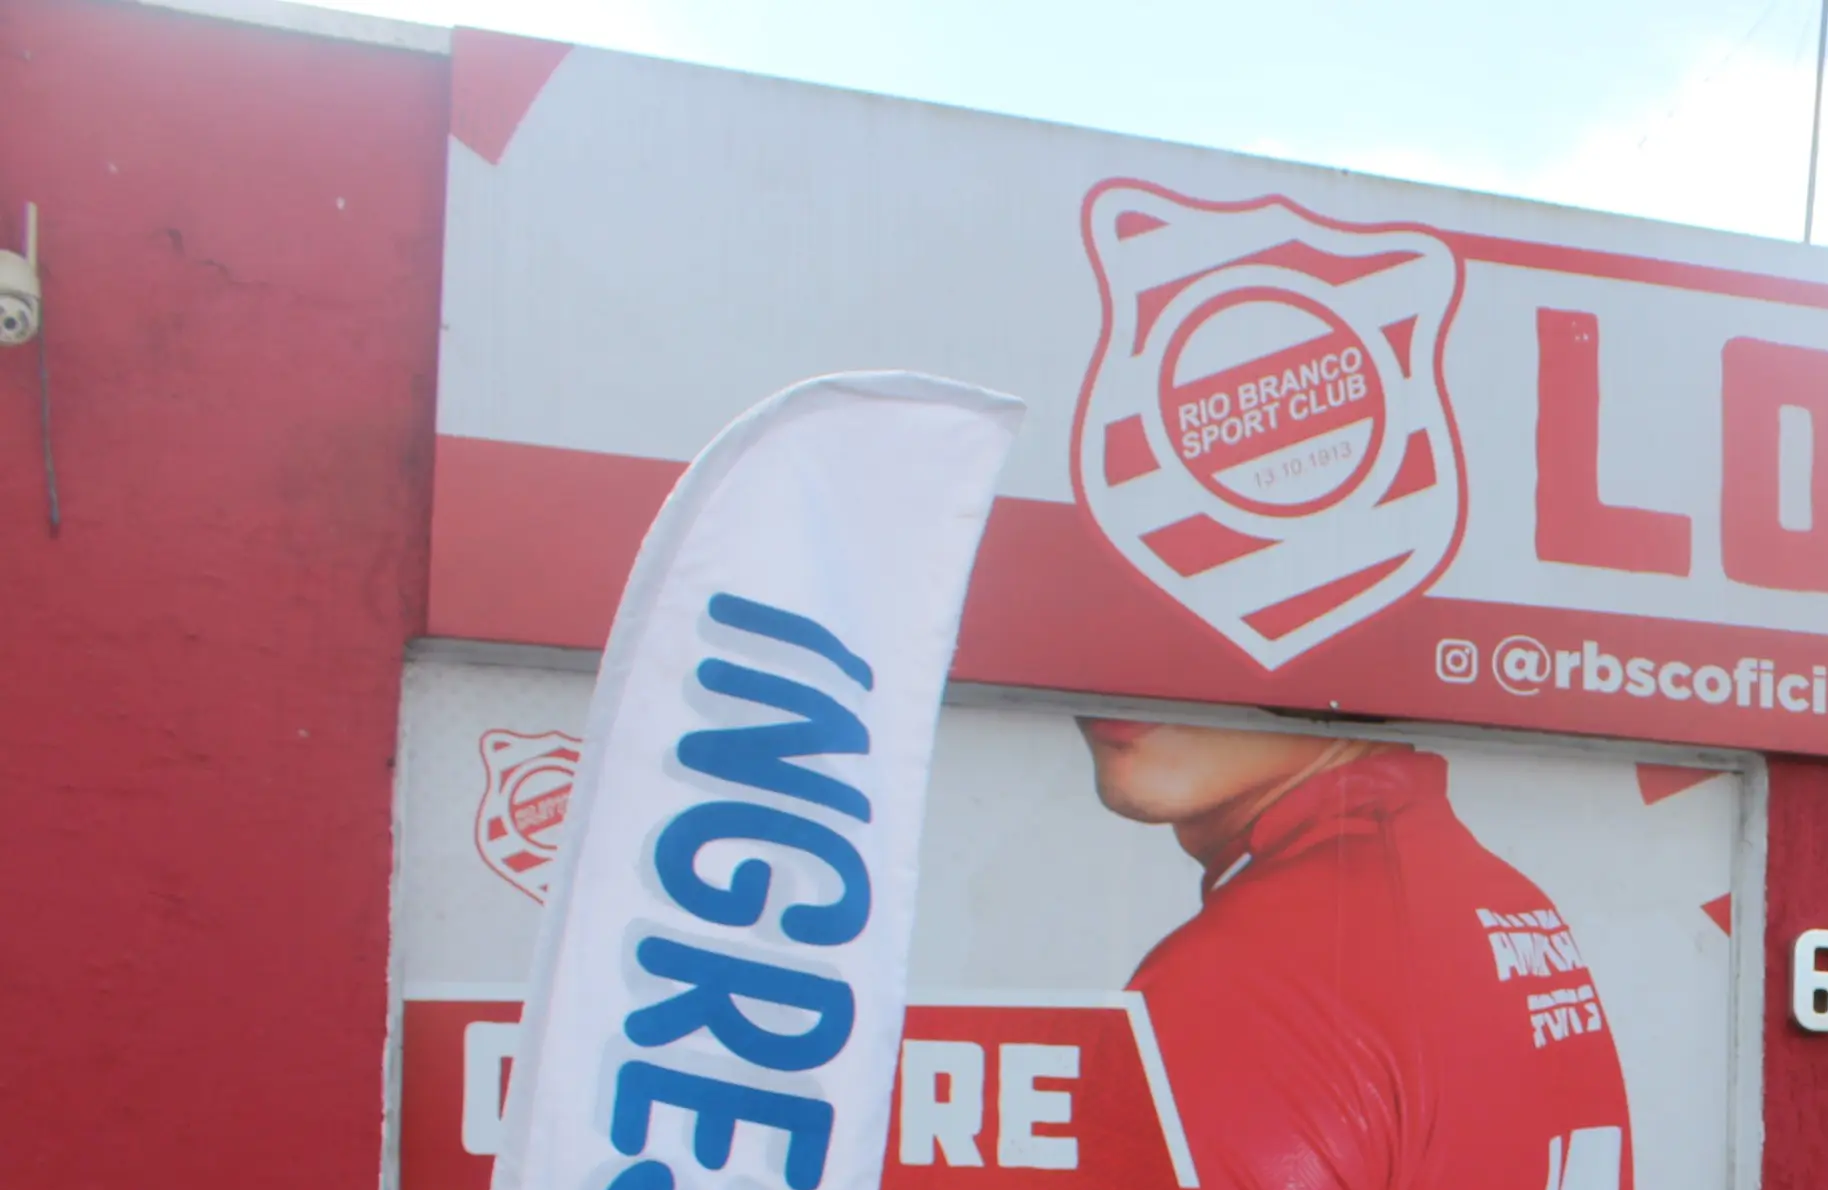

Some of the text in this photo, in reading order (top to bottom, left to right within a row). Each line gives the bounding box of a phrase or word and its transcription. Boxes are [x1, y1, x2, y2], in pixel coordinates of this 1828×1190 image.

[1177, 346, 1364, 432] RIO BRANCO
[1180, 373, 1368, 460] SPORT CLUB
